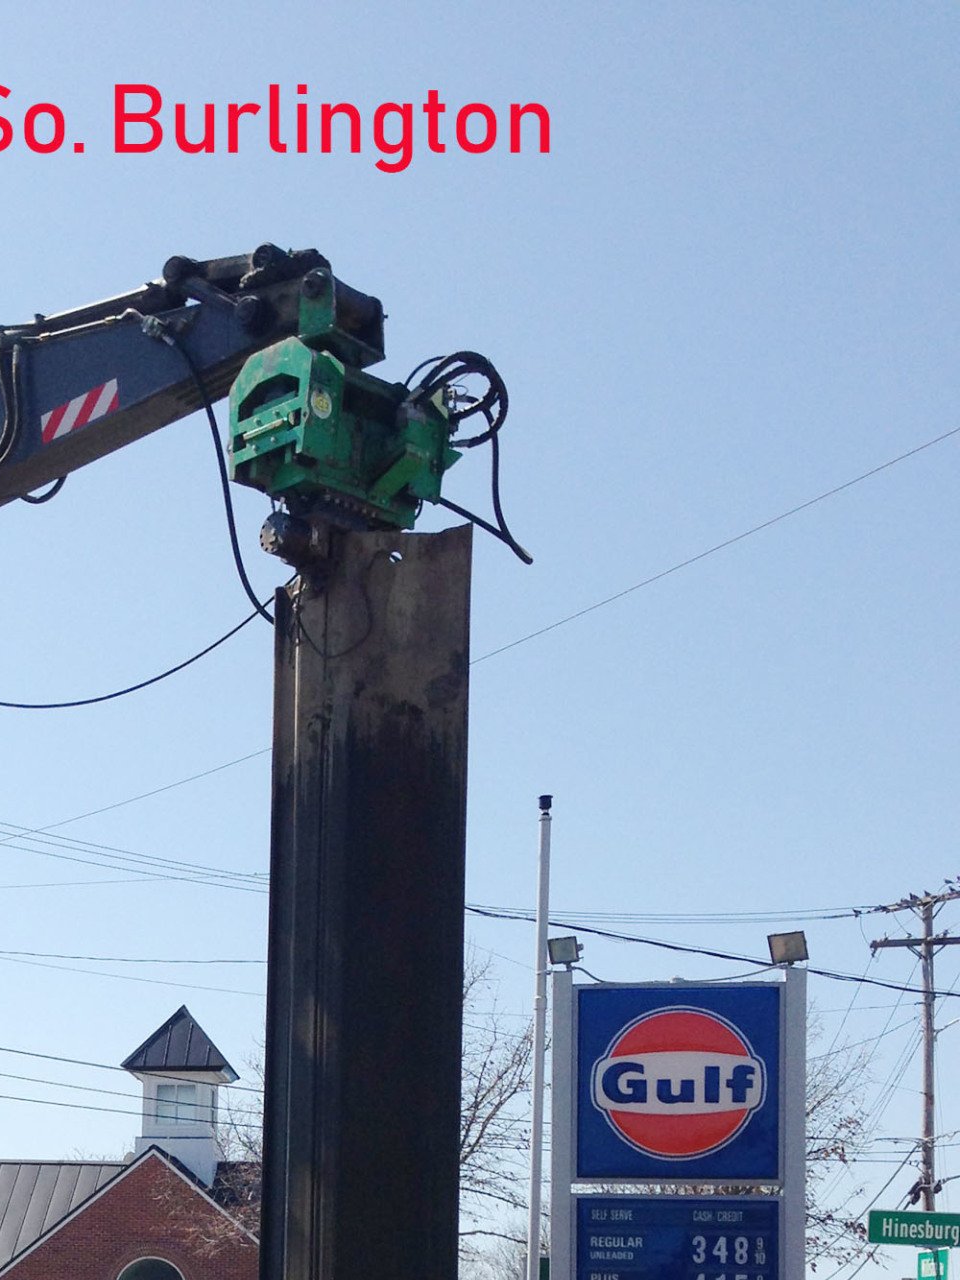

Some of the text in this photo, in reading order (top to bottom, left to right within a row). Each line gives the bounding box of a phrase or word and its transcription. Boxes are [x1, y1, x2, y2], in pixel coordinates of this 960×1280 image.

[601, 1062, 755, 1104] Gulf
[610, 1209, 633, 1221] SERVE
[882, 1218, 959, 1245] Hinesburg
[590, 1236, 643, 1248] REGULAR
[590, 1251, 634, 1260] UNLEADED
